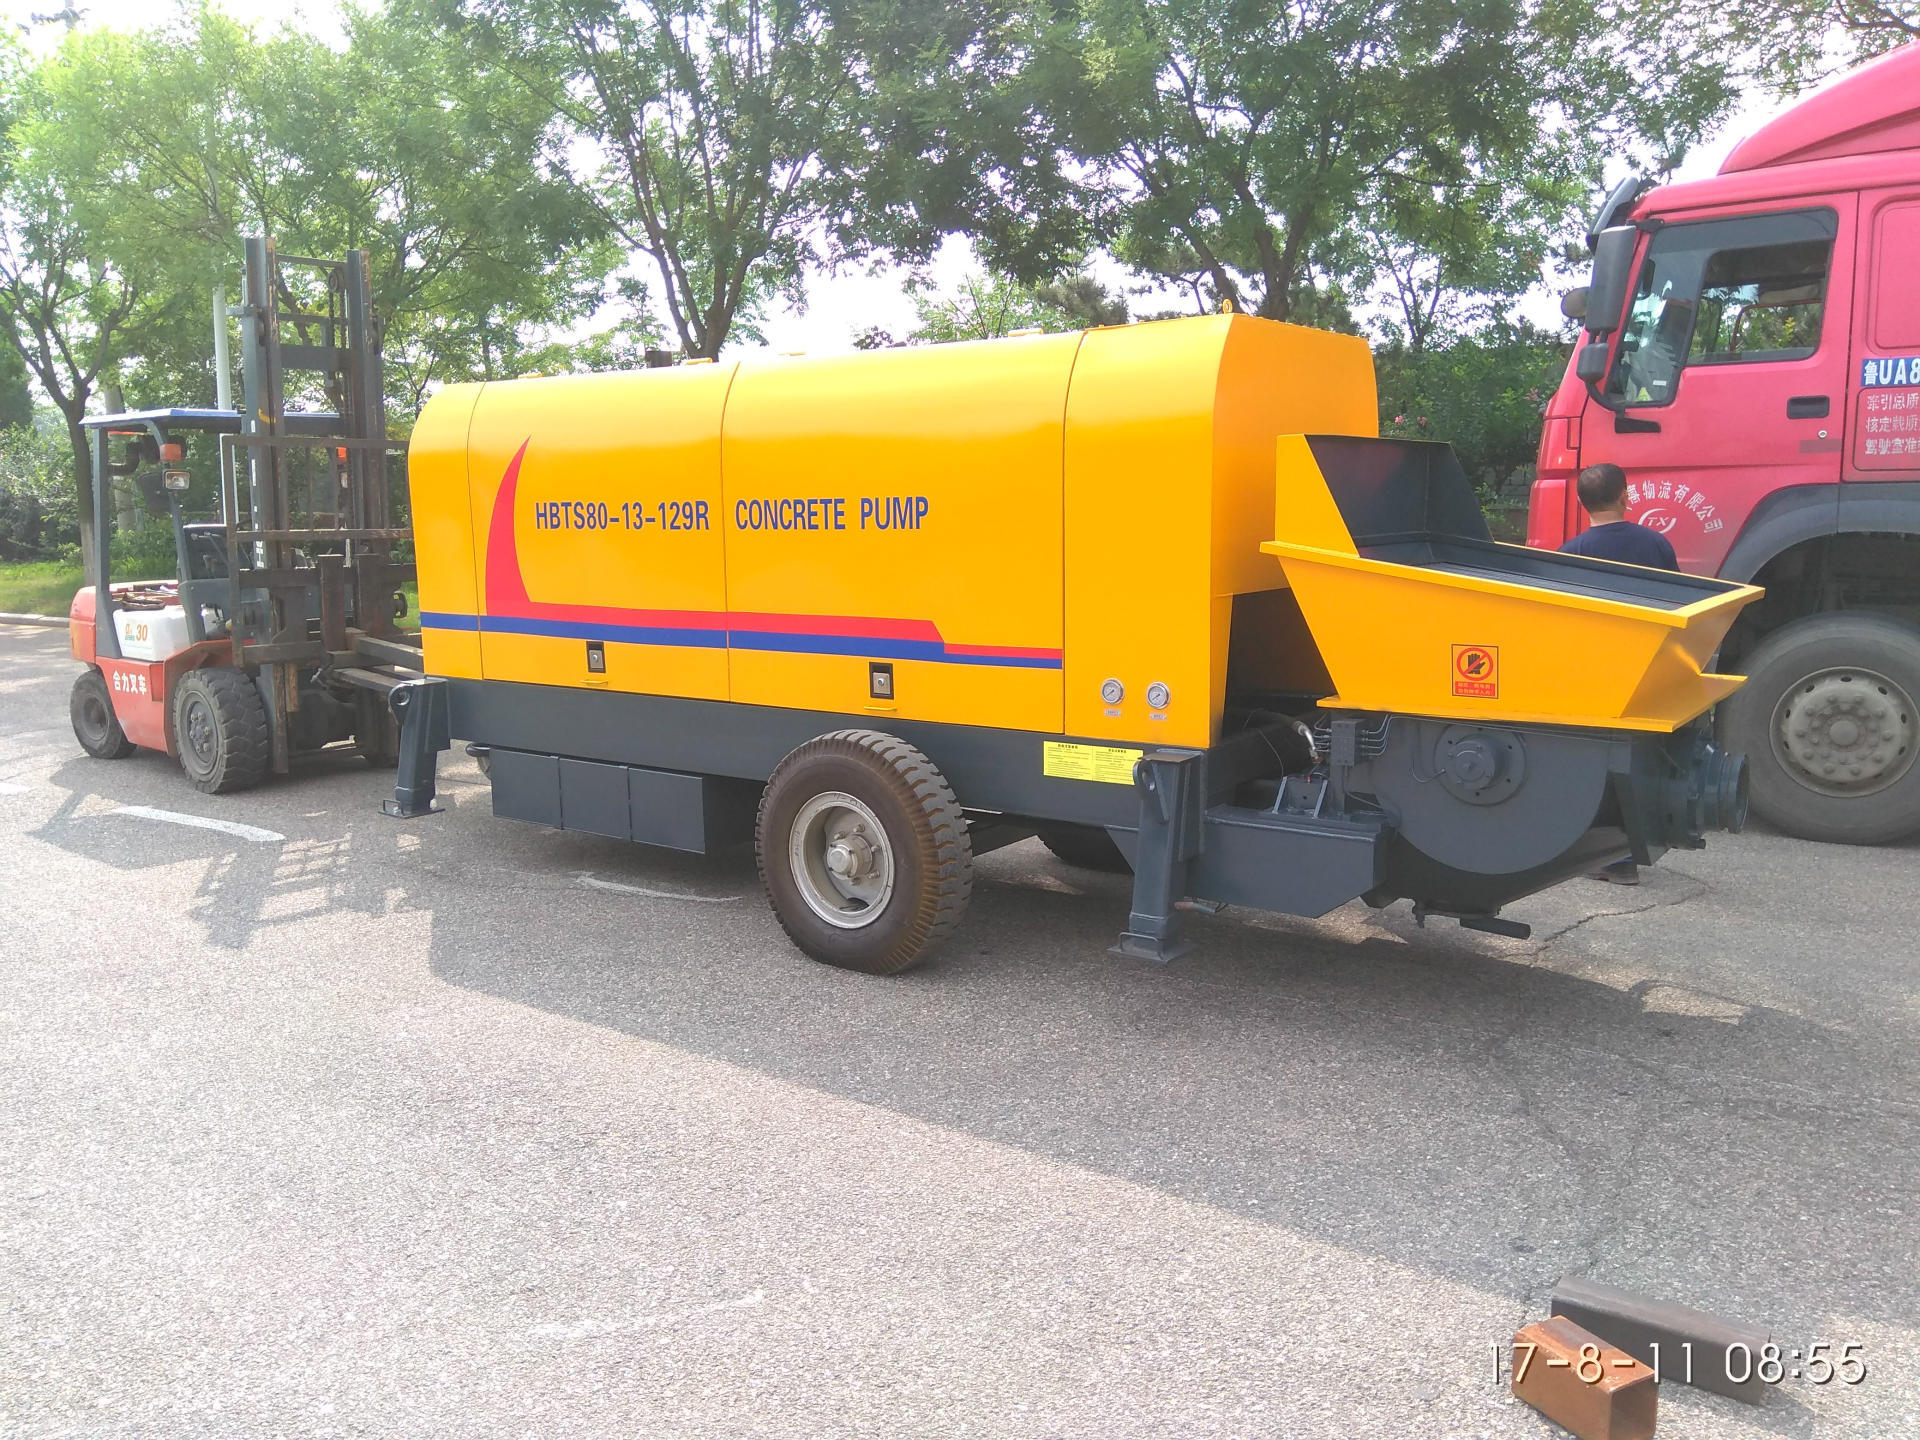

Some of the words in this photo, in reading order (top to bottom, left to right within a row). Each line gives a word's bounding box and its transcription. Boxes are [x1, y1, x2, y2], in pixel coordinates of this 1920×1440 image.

[1863, 358, 1920, 386] 鲁UA8
[1865, 415, 1920, 433] 核定载质
[1865, 437, 1920, 455] 驾驶室准
[535, 500, 710, 531] HBTS80-13-129R
[735, 498, 846, 530] CONCRETE
[860, 496, 929, 530] PUMP
[136, 623, 149, 641] 30
[112, 669, 148, 695] 合力叉车
